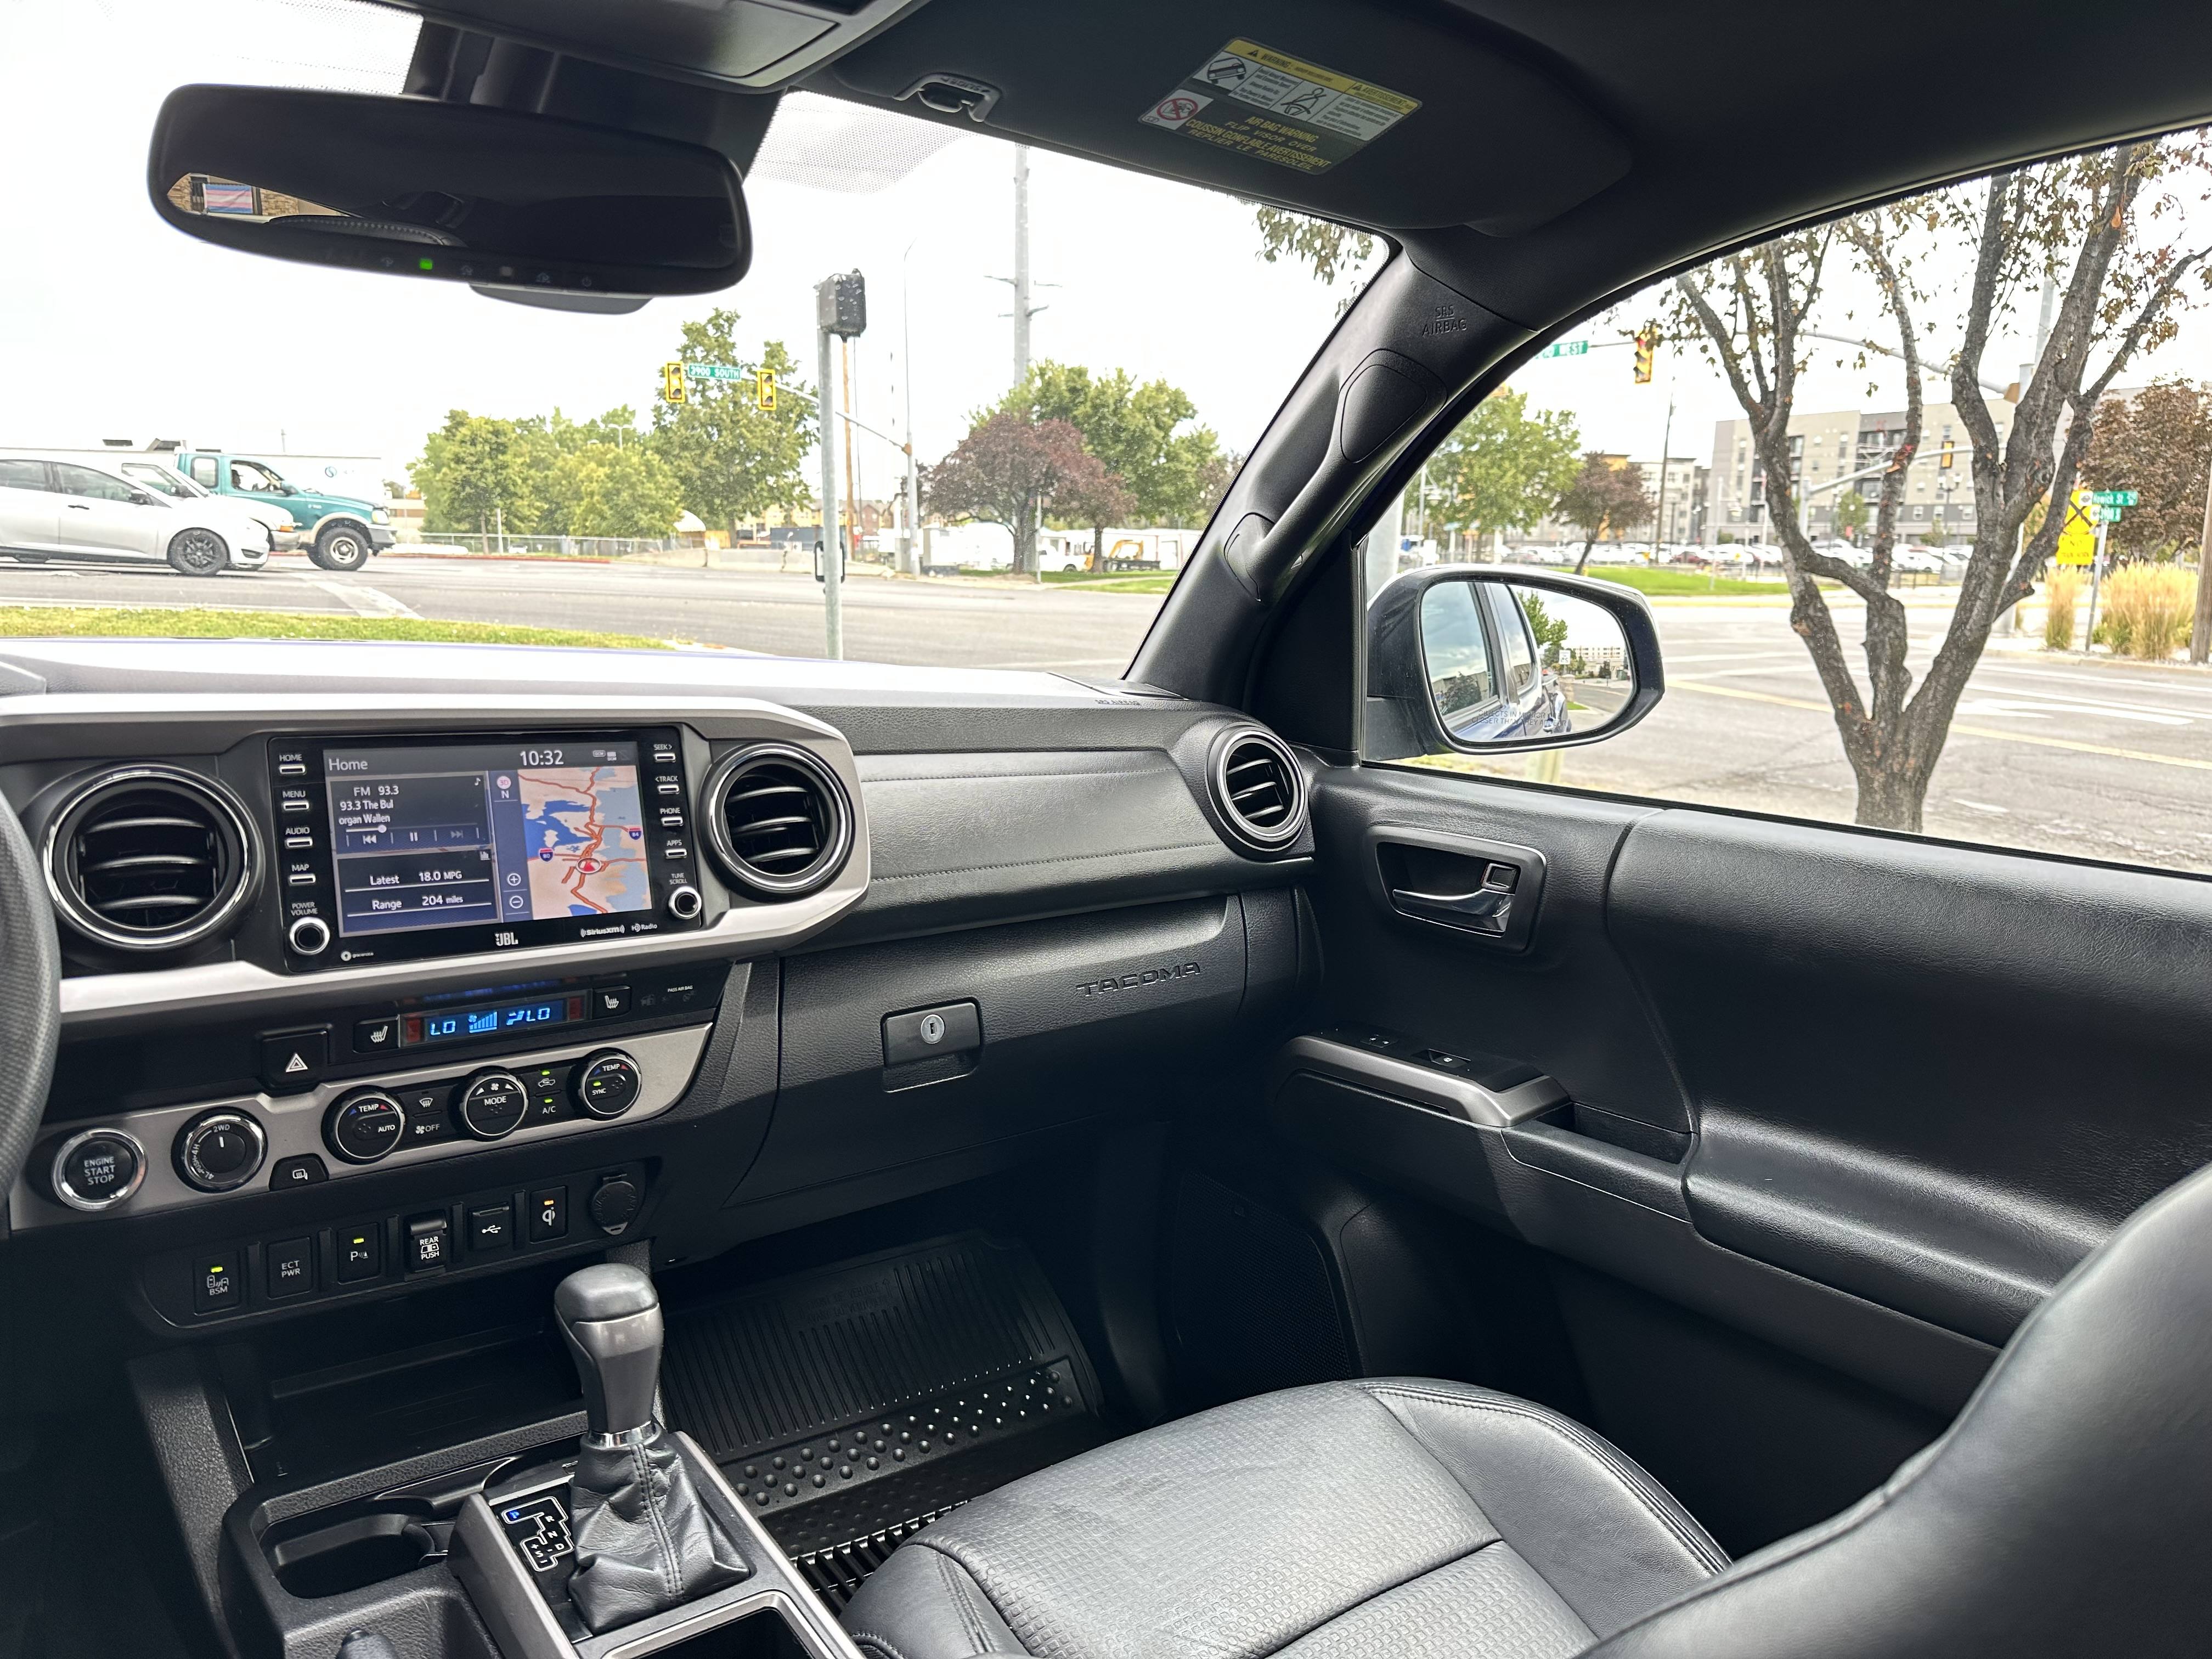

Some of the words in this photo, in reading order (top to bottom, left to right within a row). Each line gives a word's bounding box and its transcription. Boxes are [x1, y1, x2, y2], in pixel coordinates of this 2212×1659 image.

[1245, 116, 1262, 126] AIR
[1261, 120, 1282, 132] BAG
[1280, 126, 1319, 143] WARNING
[1225, 121, 1250, 131] FLIP
[1254, 130, 1285, 143] VISOR
[1288, 141, 1317, 153] OVER
[1186, 119, 1224, 136] COUSSIN
[1222, 131, 1272, 150] GONFLABLE
[1268, 144, 1332, 167] AVERTISSEMENT
[1188, 129, 1234, 146] REPLIER
[1255, 150, 1315, 170] PARESOLEIL
[1435, 305, 1454, 318] SRS
[1422, 319, 1467, 337] AIRBAG
[714, 368, 739, 379] SOUTH
[520, 750, 564, 766] 10:32
[329, 758, 368, 771] Home
[354, 787, 370, 797] FM
[378, 786, 399, 795] 93.3
[501, 791, 510, 799] N
[340, 801, 361, 811] 93.3
[362, 800, 379, 810] The
[338, 816, 362, 827] organ
[363, 814, 391, 824] Wallen
[285, 827, 310, 835] AUDIO
[291, 864, 310, 872] MAP
[370, 874, 400, 886] Latest
[419, 871, 441, 882] 18.0
[443, 871, 462, 880] MPG
[292, 901, 315, 910] POWER
[372, 899, 402, 911] Range
[422, 895, 443, 906] 204
[445, 895, 464, 904] miles
[291, 907, 318, 916] VOLUME
[495, 932, 519, 946] JBL
[1076, 962, 1200, 997] TACOMA
[602, 1063, 620, 1071] TEMP
[484, 1096, 507, 1106] MODE
[358, 1103, 379, 1113] TEMP
[542, 1105, 556, 1114] A/C
[213, 1124, 230, 1133] 2WD
[378, 1125, 396, 1133] AUTO
[425, 1124, 441, 1132] OFF
[84, 1156, 115, 1167] ENGINE
[84, 1165, 115, 1177] START
[88, 1174, 115, 1185] STOP
[420, 1235, 439, 1246] REAR
[351, 1251, 358, 1261] P
[421, 1251, 439, 1260] PUSH
[281, 1260, 300, 1270] ECT
[281, 1268, 301, 1278] PWR
[209, 1285, 228, 1296] BSM
